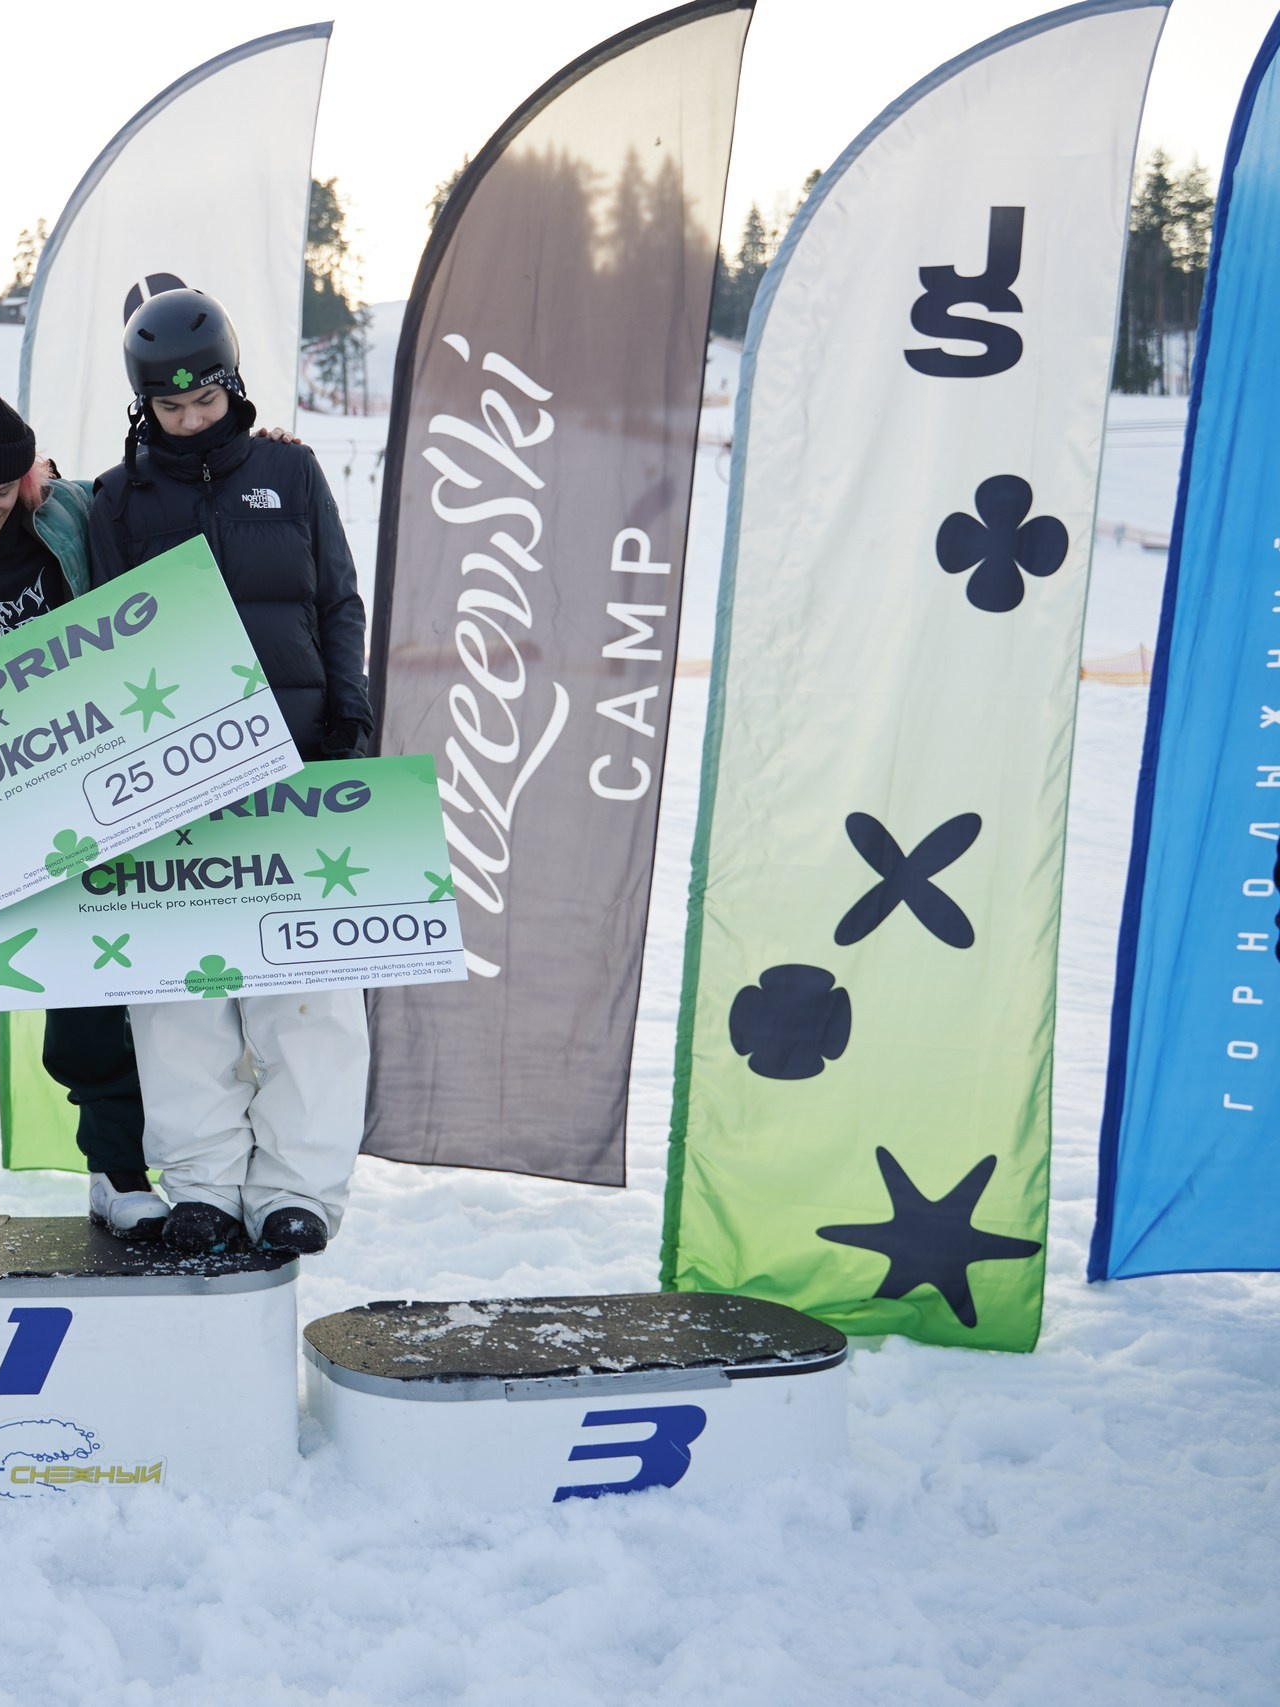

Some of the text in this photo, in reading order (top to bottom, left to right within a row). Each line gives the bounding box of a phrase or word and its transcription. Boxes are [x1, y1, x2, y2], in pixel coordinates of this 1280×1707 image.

[200, 369, 226, 386] GIRO
[249, 501, 269, 509] FACE
[252, 488, 267, 496] THE
[421, 332, 570, 979] uzeevski
[588, 526, 672, 801] CAMP
[4, 784, 23, 801] pro
[24, 762, 68, 789] контест
[70, 736, 126, 768] сноуборд
[105, 760, 154, 807] 25
[23, 857, 65, 880] Сертификат
[65, 846, 89, 862] можно
[89, 824, 136, 850] использовать
[142, 790, 209, 825] интернет-магазине
[260, 761, 270, 769] на
[271, 754, 286, 765] всю
[74, 857, 85, 866] на
[84, 848, 109, 862] деньги
[154, 801, 204, 830] Действителен
[204, 797, 214, 807] до
[213, 793, 222, 802] 31
[222, 781, 251, 798] августа
[251, 770, 270, 785] 2024
[209, 779, 372, 822] RING
[81, 852, 295, 897] CHUKCHA
[78, 892, 302, 913] Knuckle Huck pro контест сноуборд
[277, 921, 320, 951] 15
[104, 988, 154, 998] продуктовую
[227, 981, 253, 991] деньги
[305, 975, 360, 984] Действителен
[380, 971, 411, 980] августа
[412, 968, 432, 976] 2024
[159, 977, 206, 987] Сертификат
[207, 975, 233, 984] можно
[234, 972, 287, 982] использовать
[294, 966, 369, 977] интернет-магазине
[10, 1461, 163, 1485] СНЕЖНЫЙ
[552, 1404, 708, 1503] 3
